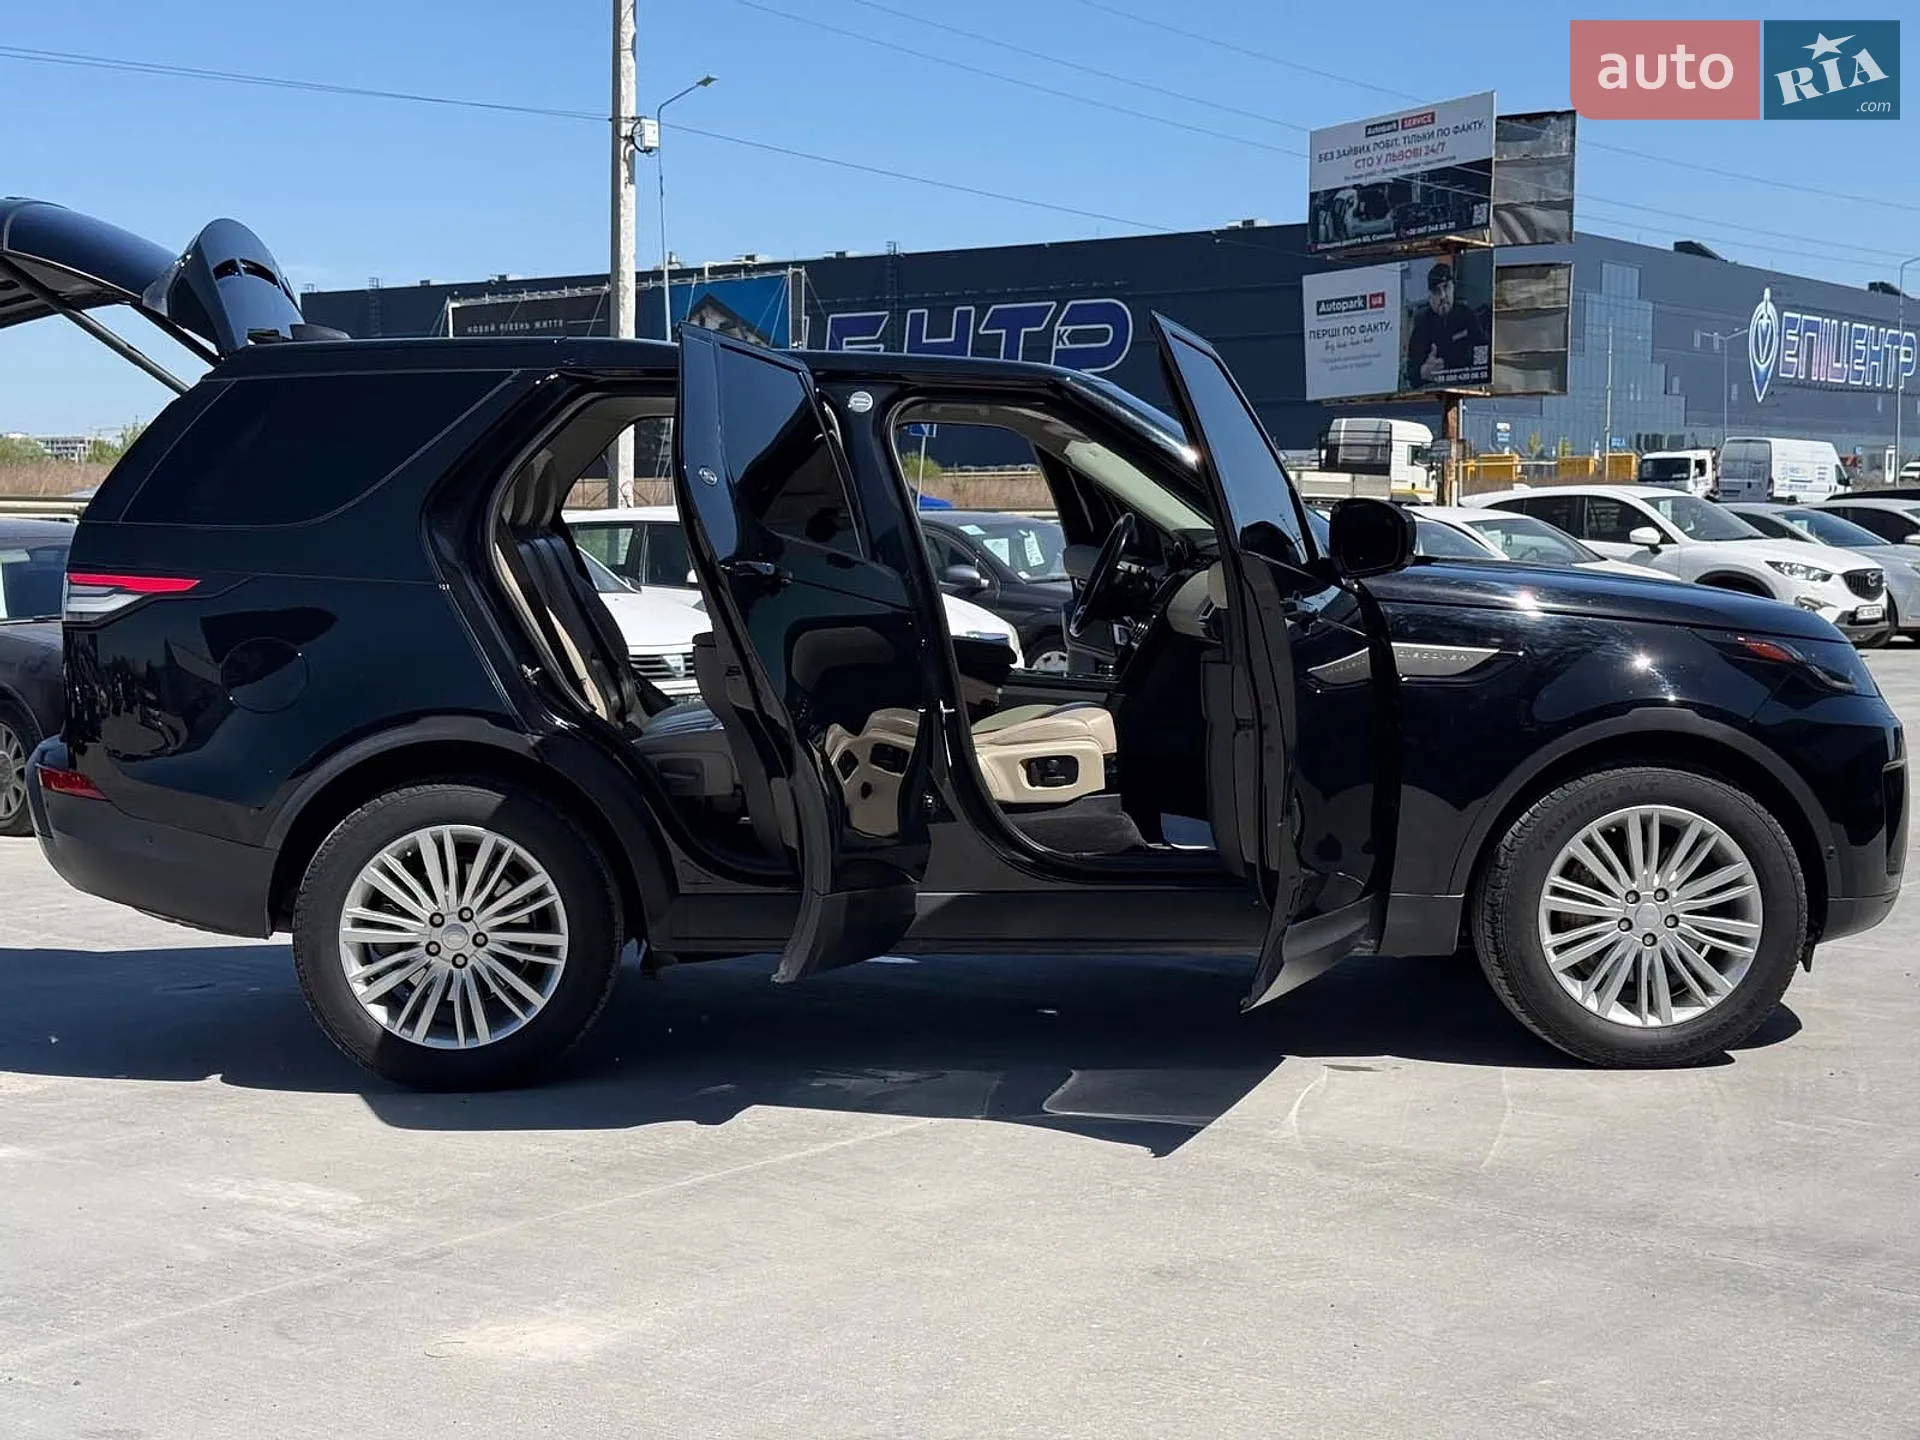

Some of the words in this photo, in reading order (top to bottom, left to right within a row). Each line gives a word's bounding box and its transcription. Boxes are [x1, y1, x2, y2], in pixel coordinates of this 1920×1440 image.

[1318, 152, 1334, 163] БЕЗ
[1436, 128, 1451, 138] ПО
[1354, 157, 1374, 169] СТО
[1375, 155, 1382, 165] У
[1384, 148, 1422, 163] ЛЬВОВІ
[1425, 142, 1446, 155] 24/7
[1319, 297, 1364, 312] Autopark
[1309, 326, 1341, 339] ПЕРШІ
[1342, 326, 1356, 337] ПО
[1778, 311, 1918, 390] ЕПІЦЕНТР
